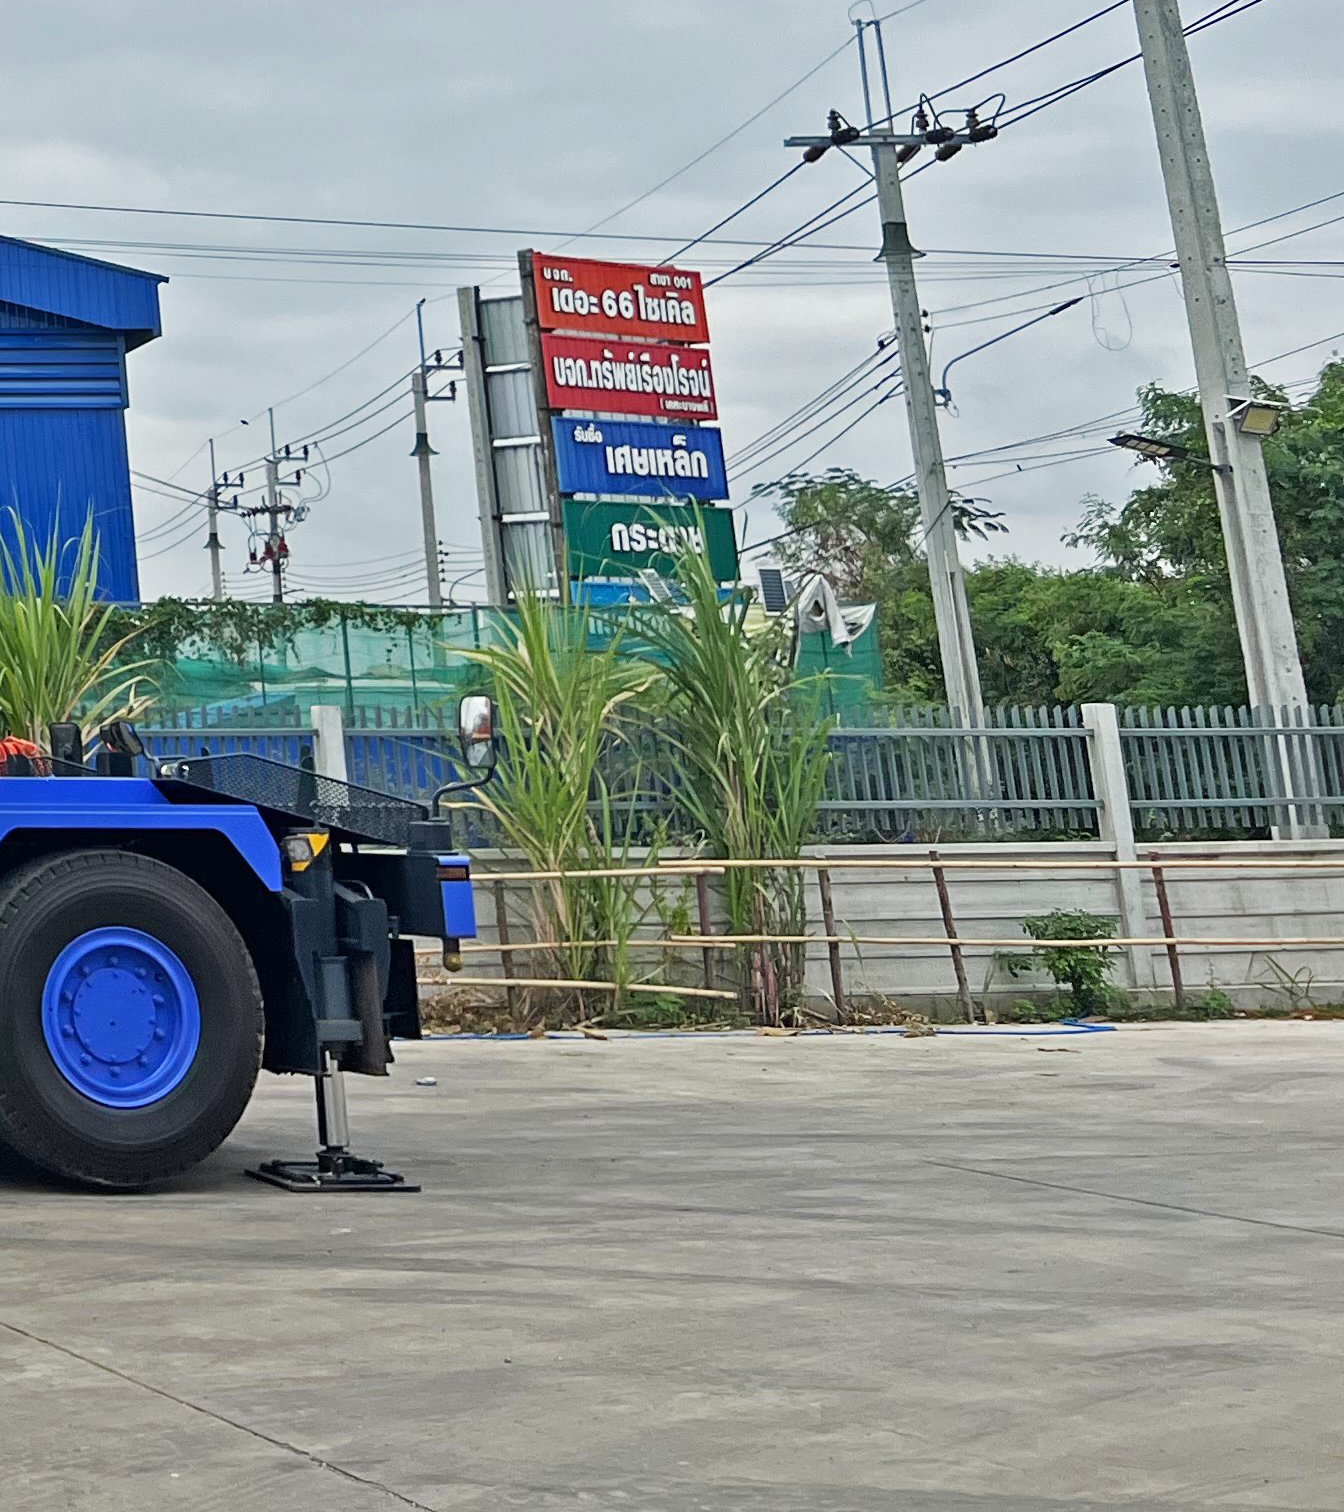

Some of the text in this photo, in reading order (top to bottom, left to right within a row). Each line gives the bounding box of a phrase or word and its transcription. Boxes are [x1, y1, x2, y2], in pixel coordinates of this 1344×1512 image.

[673, 276, 692, 289] 001
[601, 289, 634, 320] 66
[606, 434, 709, 478] เศษเหล็ก
